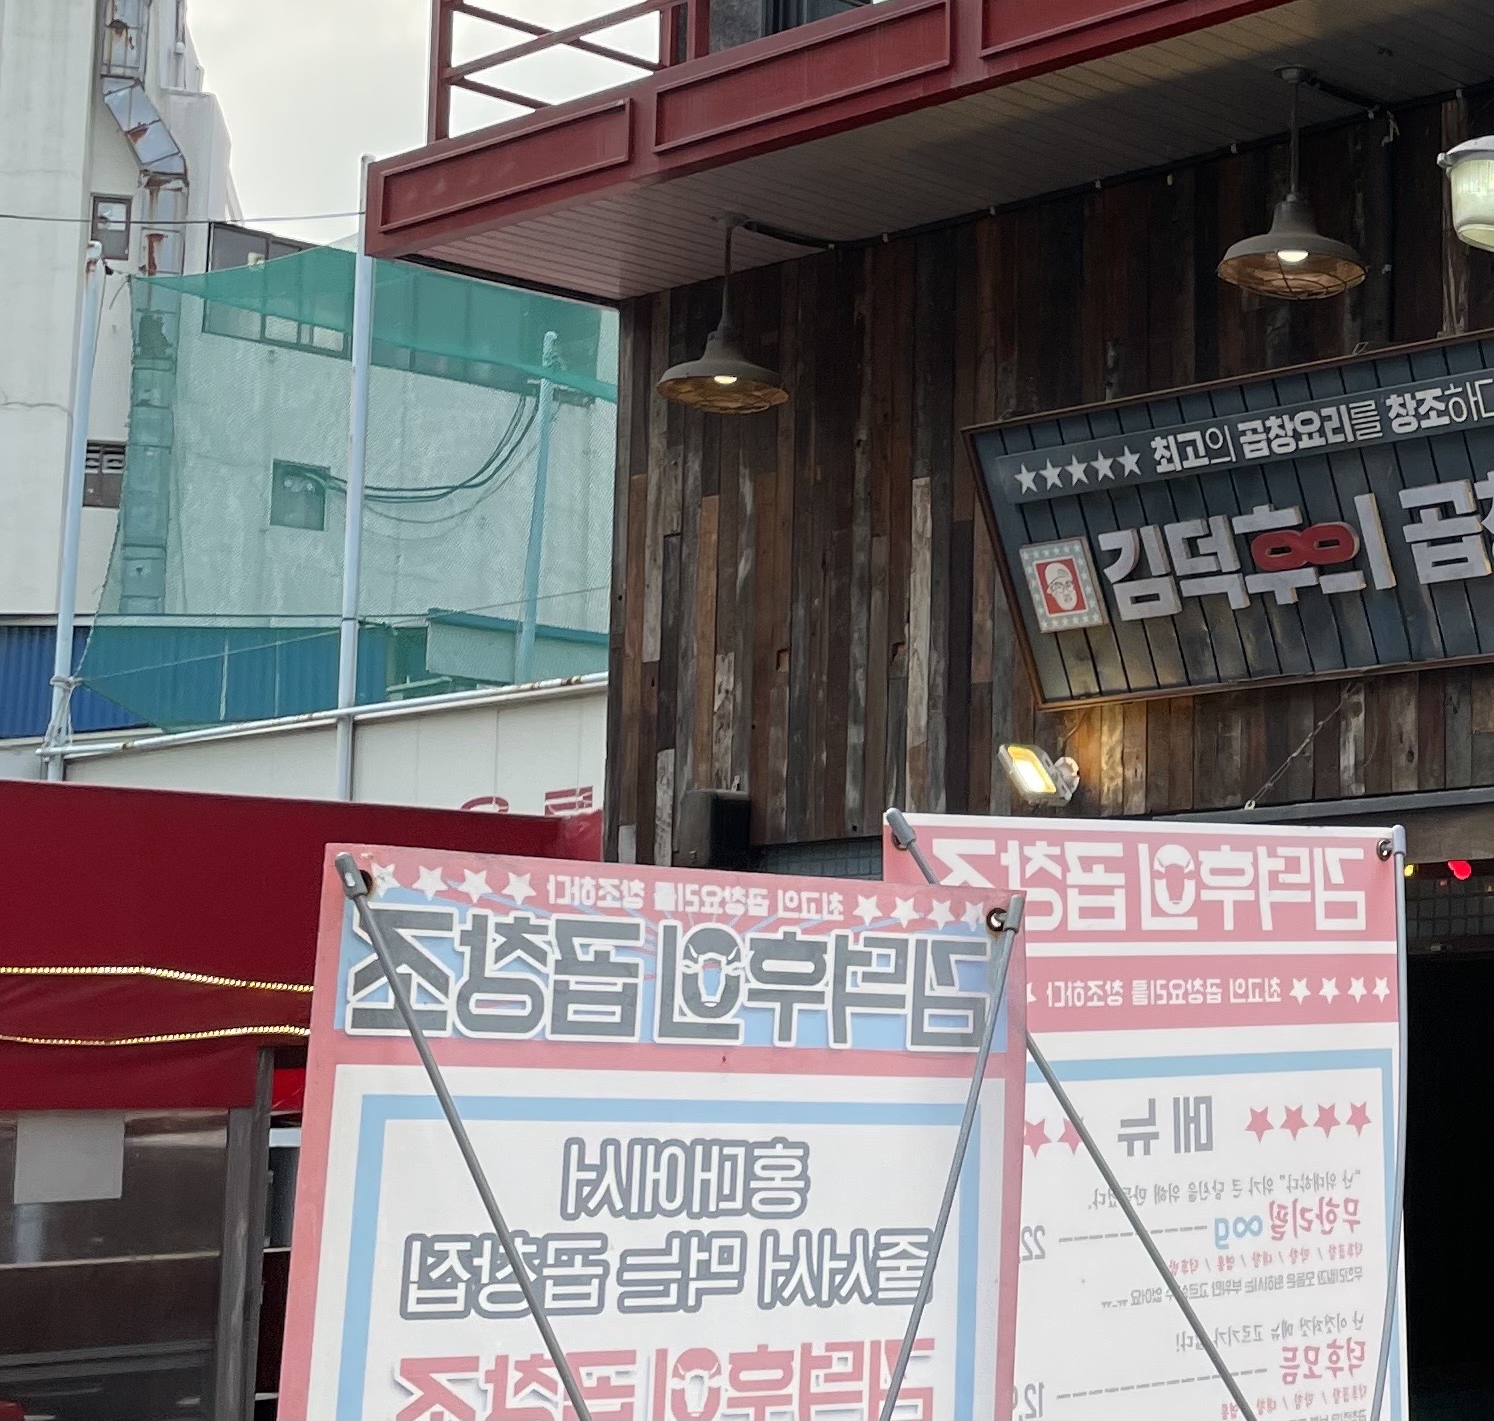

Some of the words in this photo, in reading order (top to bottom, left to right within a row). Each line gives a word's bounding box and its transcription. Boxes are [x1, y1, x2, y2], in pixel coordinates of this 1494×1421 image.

[1150, 425, 1237, 474] 최고의
[1237, 399, 1383, 461] 곱창요리를
[1098, 492, 1397, 621] 김덕후의
